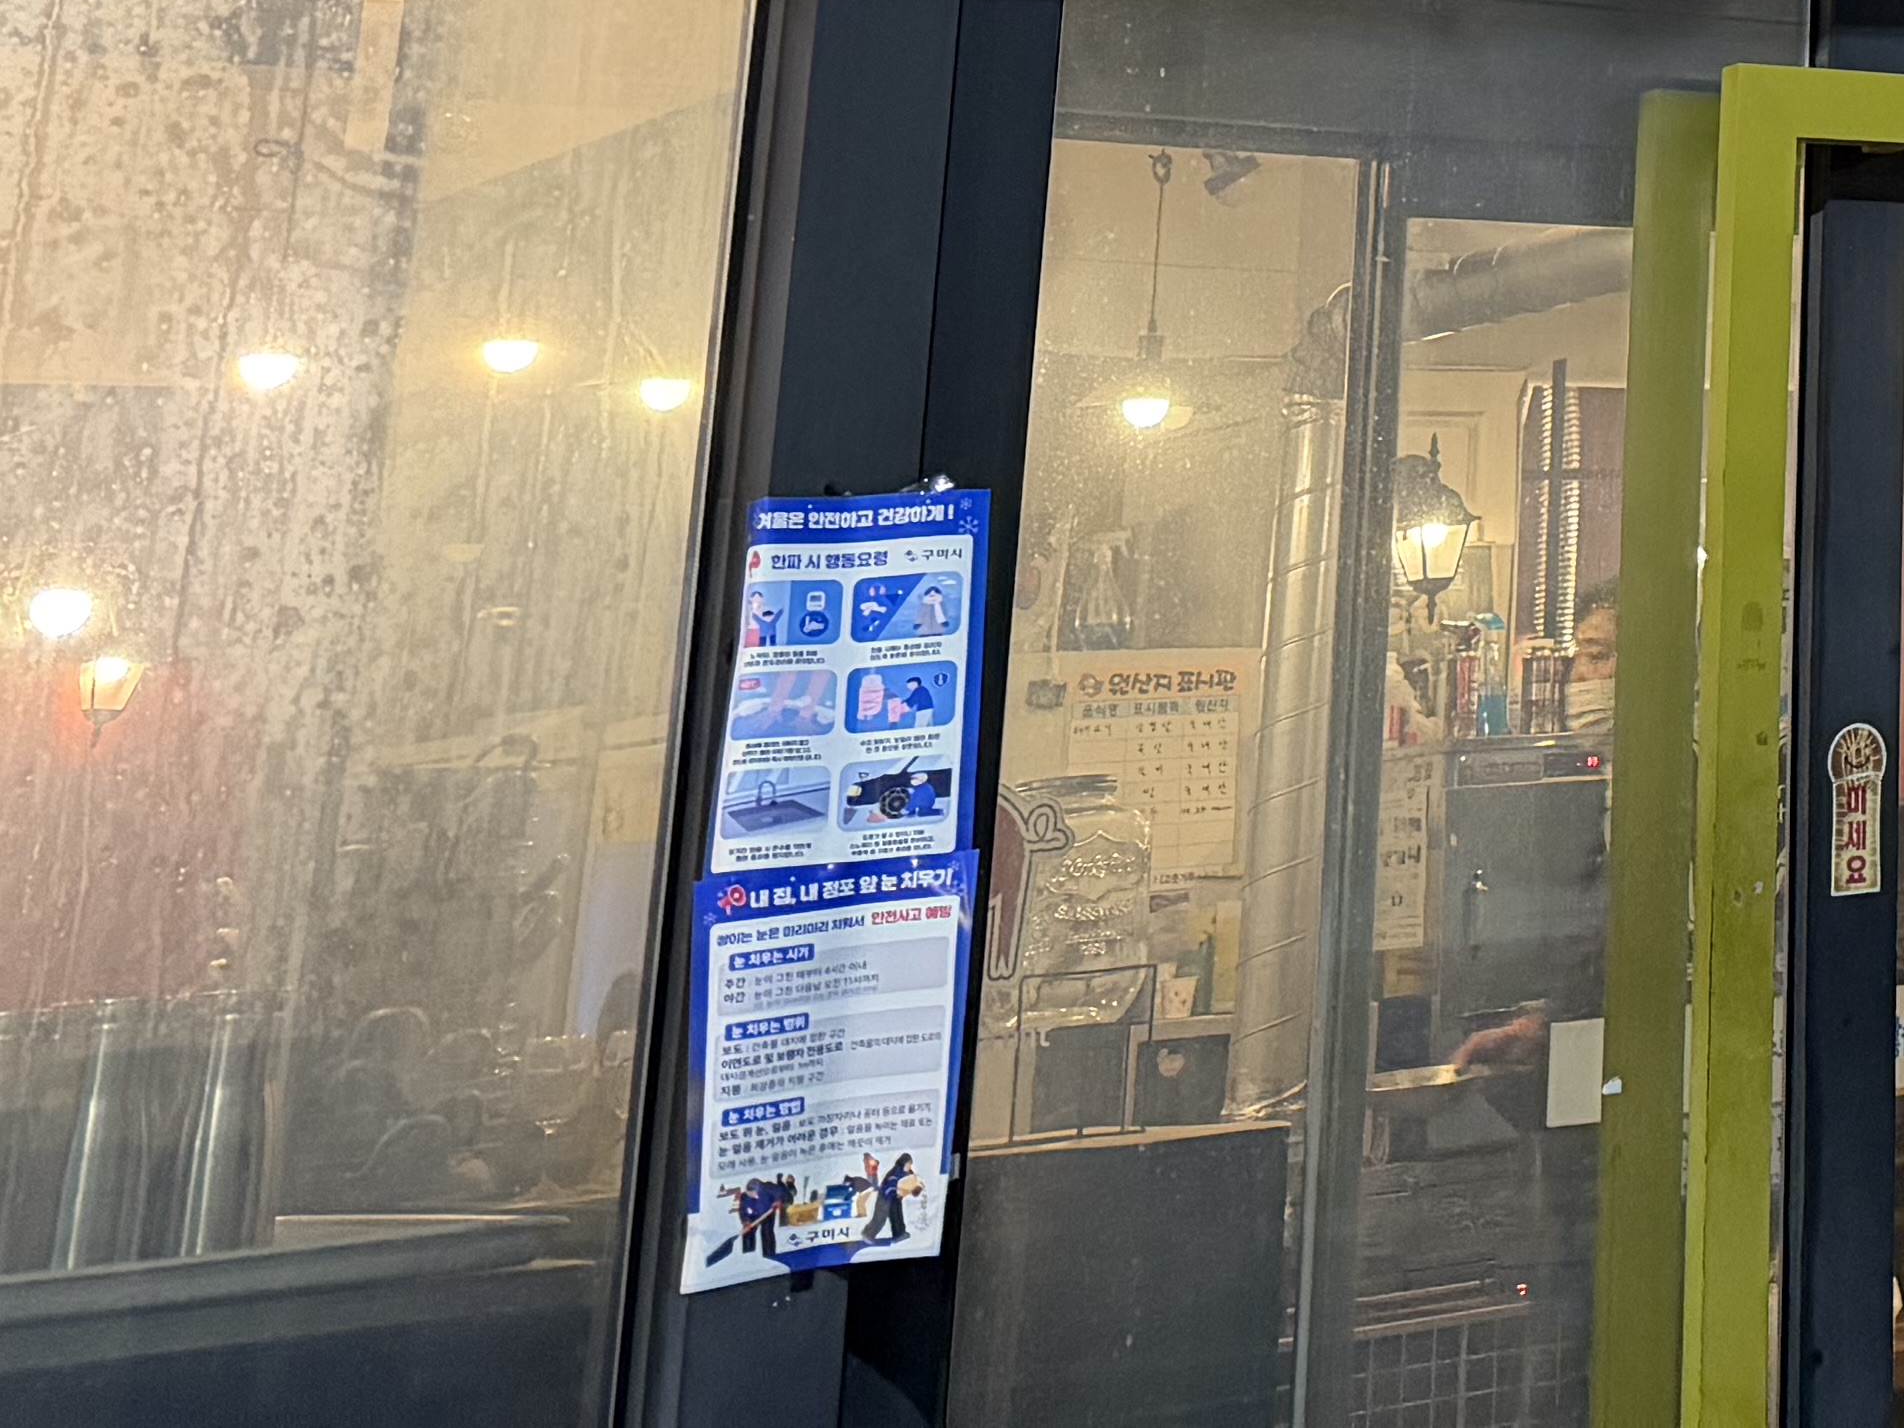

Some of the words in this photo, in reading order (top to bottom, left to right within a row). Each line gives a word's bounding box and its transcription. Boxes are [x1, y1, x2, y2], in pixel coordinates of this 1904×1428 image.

[921, 548, 963, 561] 구미시
[1108, 672, 1172, 696] 원산지
[1842, 786, 1867, 884] 미세요
[750, 889, 769, 908] 내
[773, 886, 796, 905] 집,
[800, 883, 818, 901] 내
[822, 878, 854, 899] 점포
[859, 876, 878, 895] 앞
[881, 874, 898, 891] 눈
[901, 868, 953, 889] 치우기
[871, 907, 922, 925] 안전사고
[733, 956, 746, 969] 눈
[805, 1225, 850, 1243] 구미시
